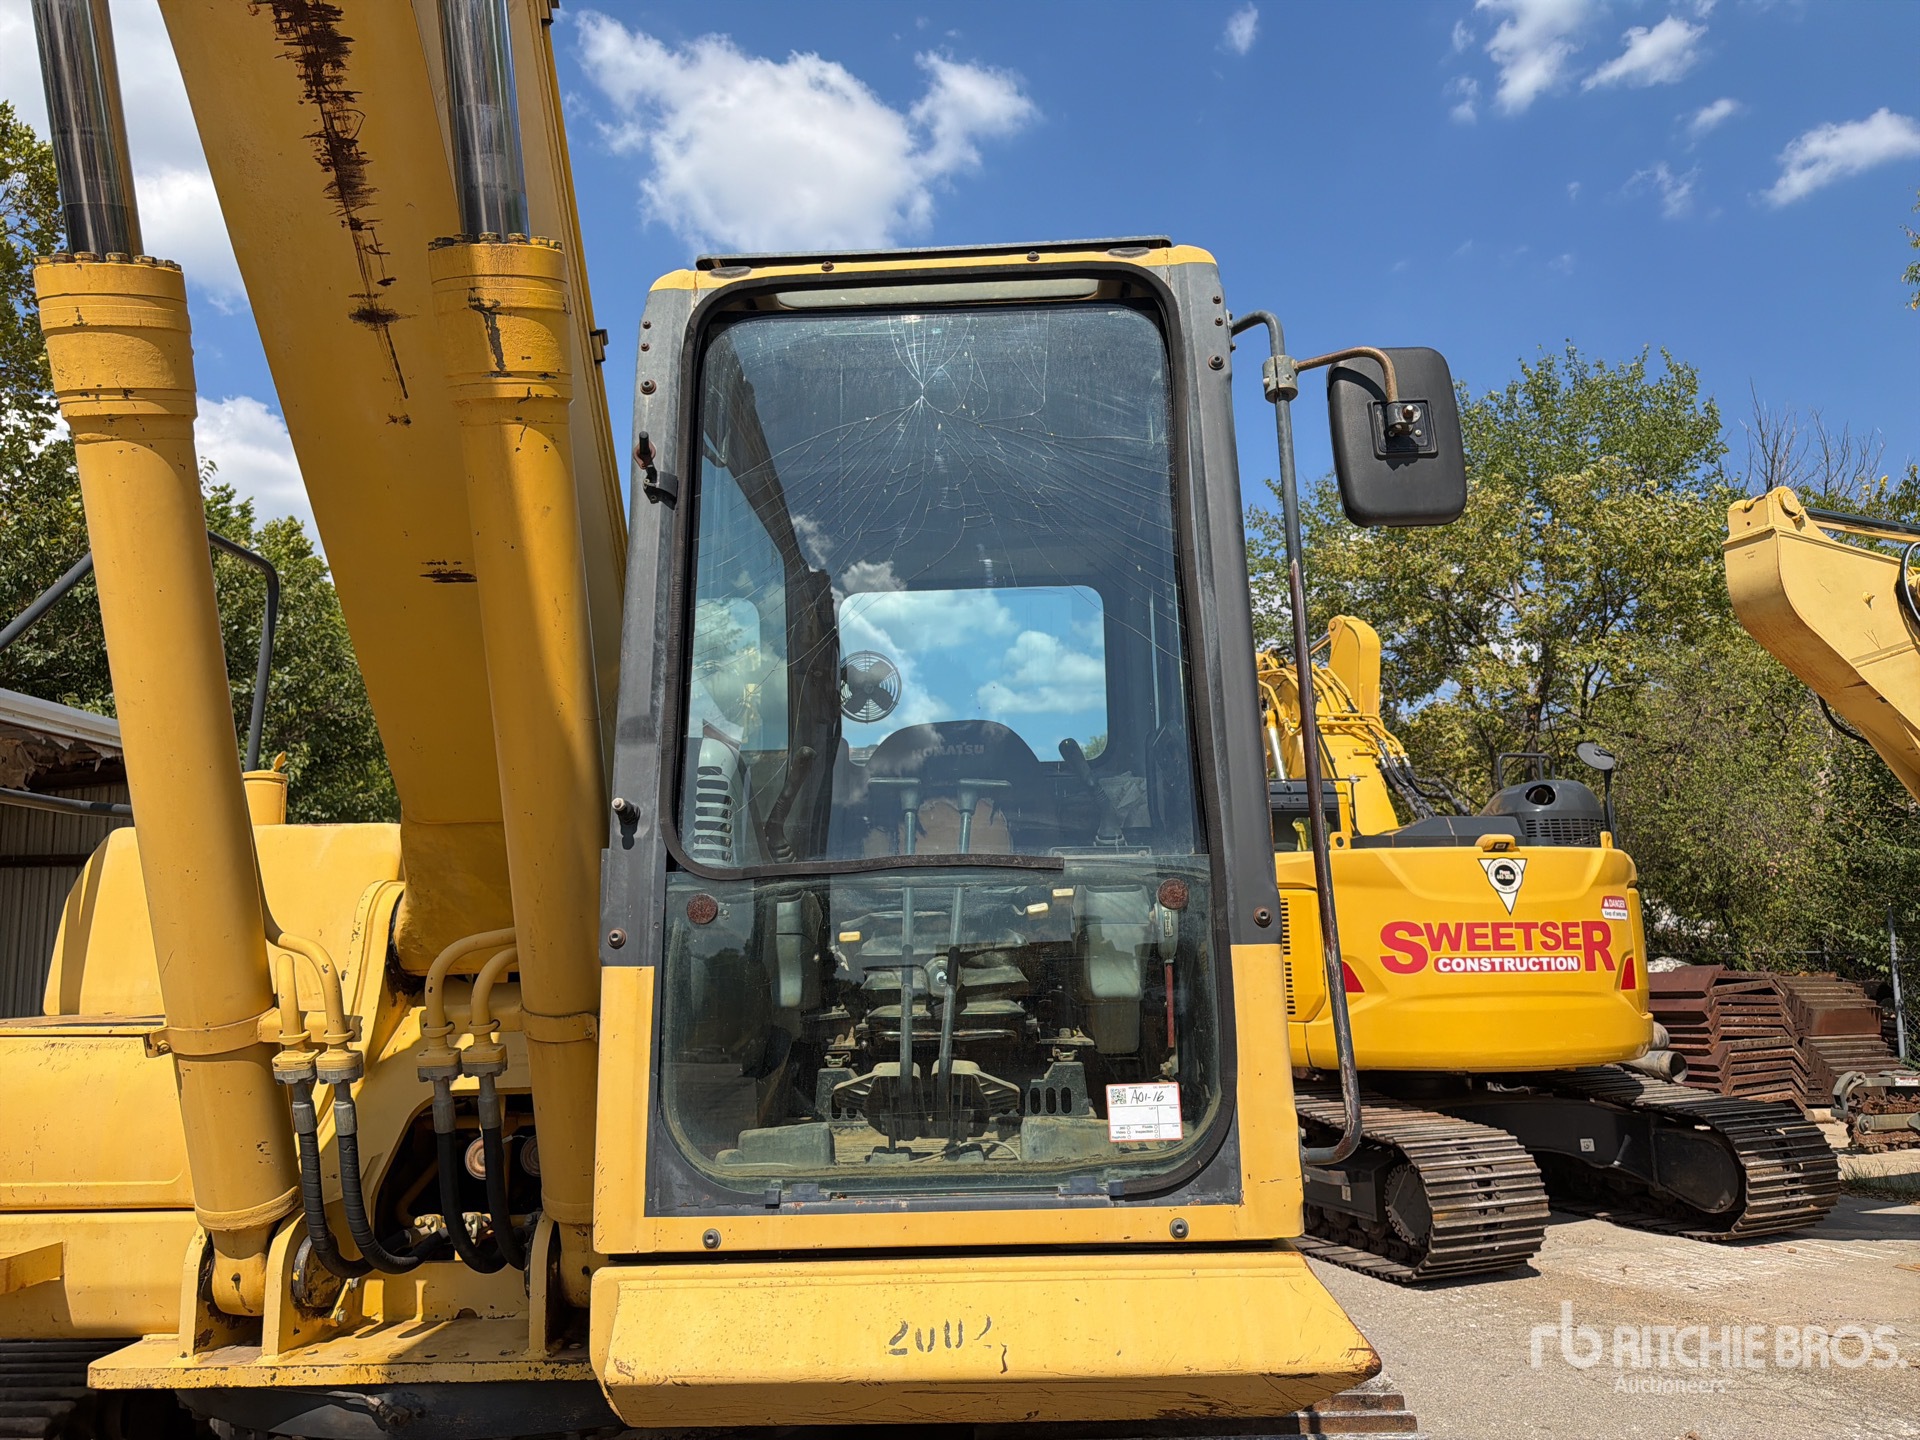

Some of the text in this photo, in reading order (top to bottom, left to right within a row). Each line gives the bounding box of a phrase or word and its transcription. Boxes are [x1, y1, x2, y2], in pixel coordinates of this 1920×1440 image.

[1380, 921, 1615, 974] SWEETSER
[1438, 957, 1578, 972] CONSTRUCTION
[1130, 1089, 1164, 1104] A01-16
